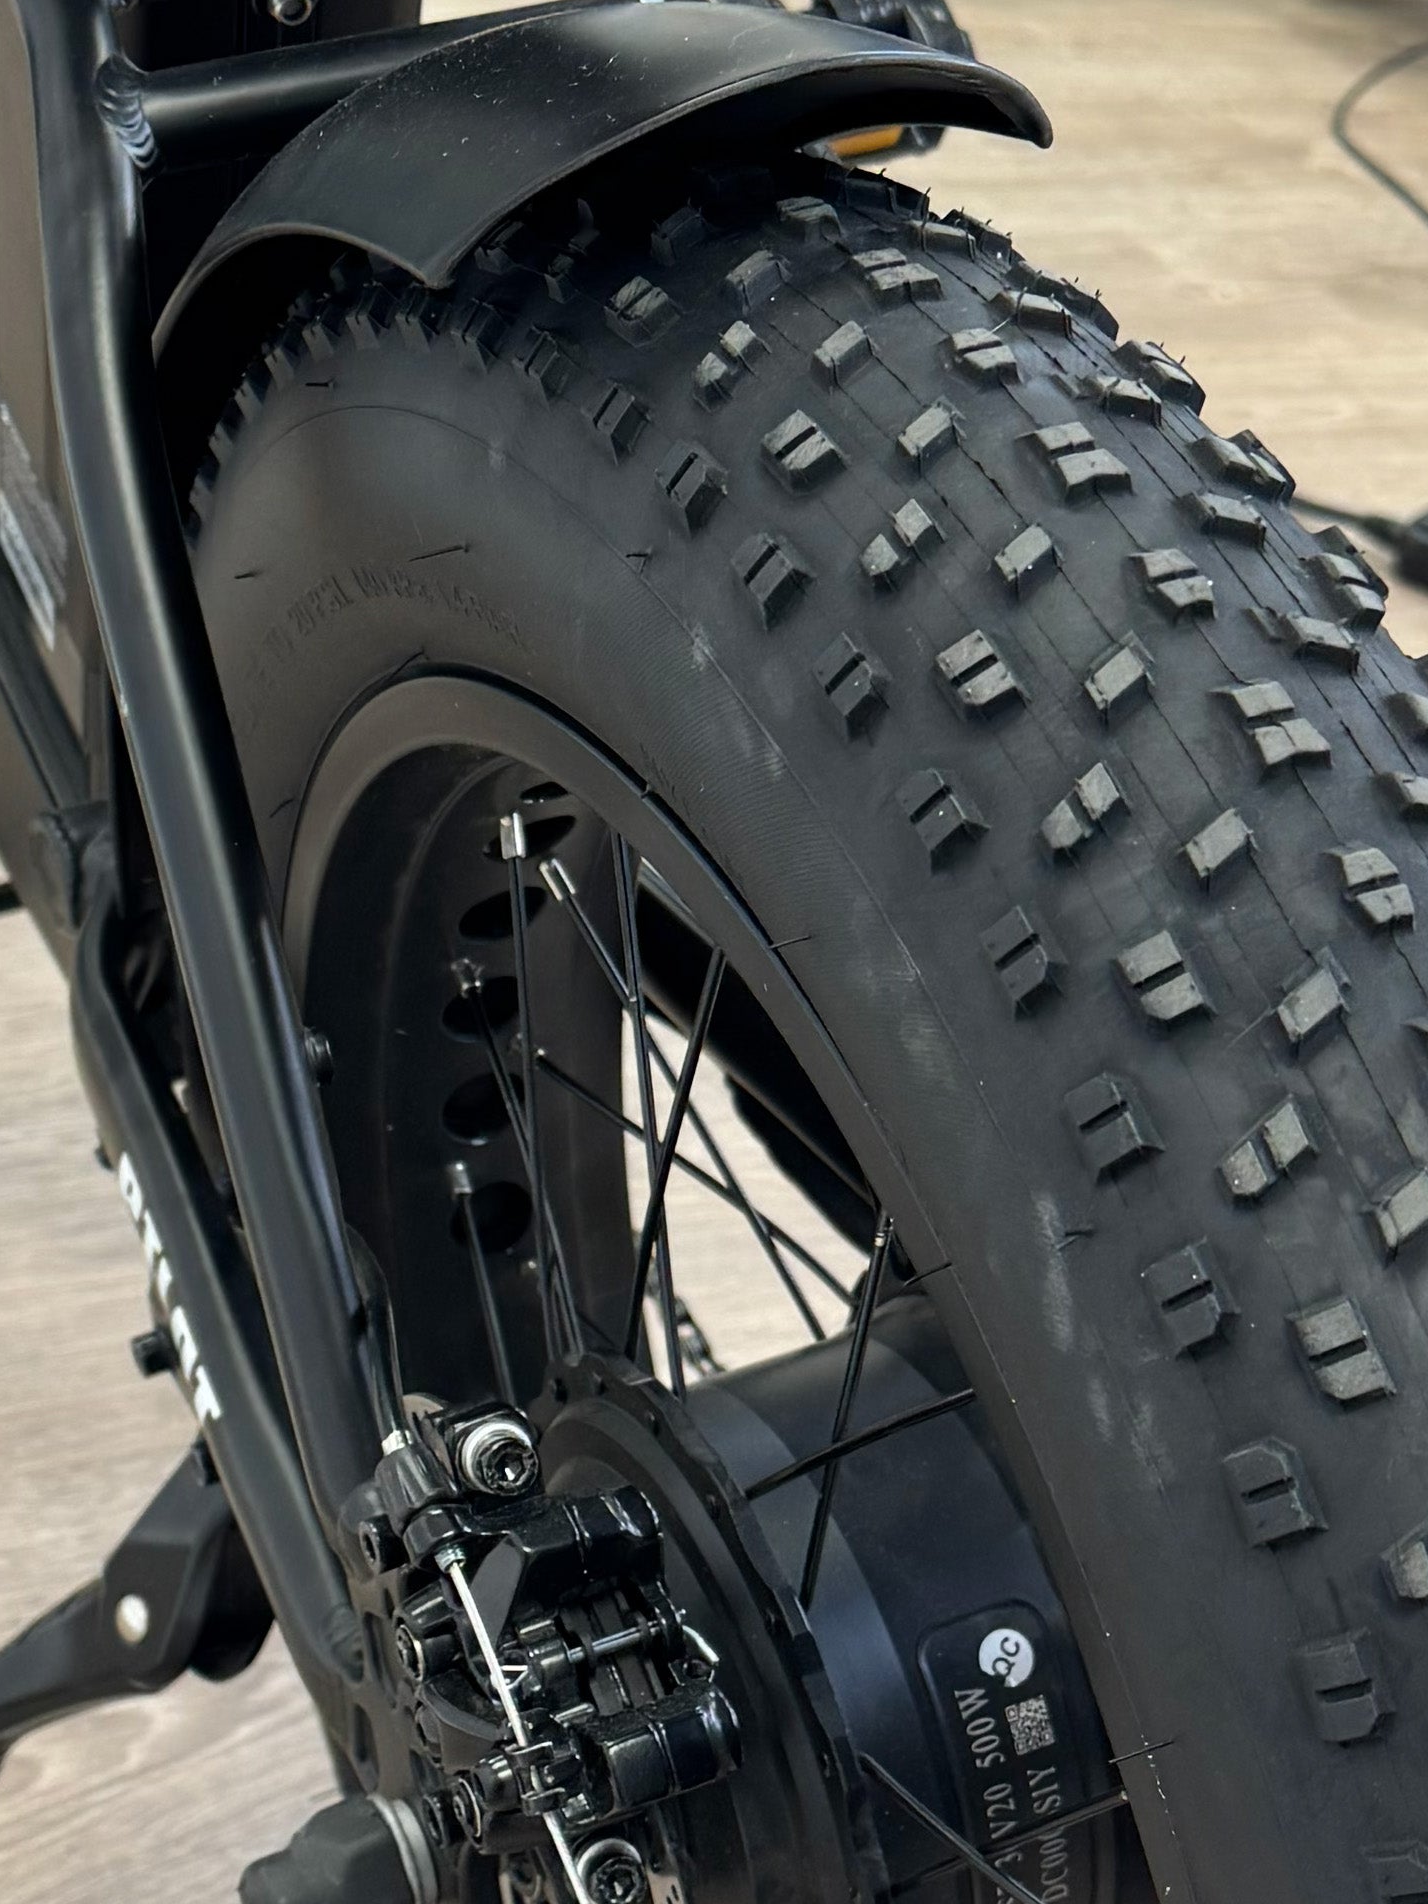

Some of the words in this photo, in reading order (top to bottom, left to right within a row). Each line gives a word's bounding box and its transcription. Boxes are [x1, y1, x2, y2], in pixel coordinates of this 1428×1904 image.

[992, 1636, 1020, 1678] QC
[954, 1688, 1006, 1768] 500W
[983, 1783, 1023, 1868] 3V20
